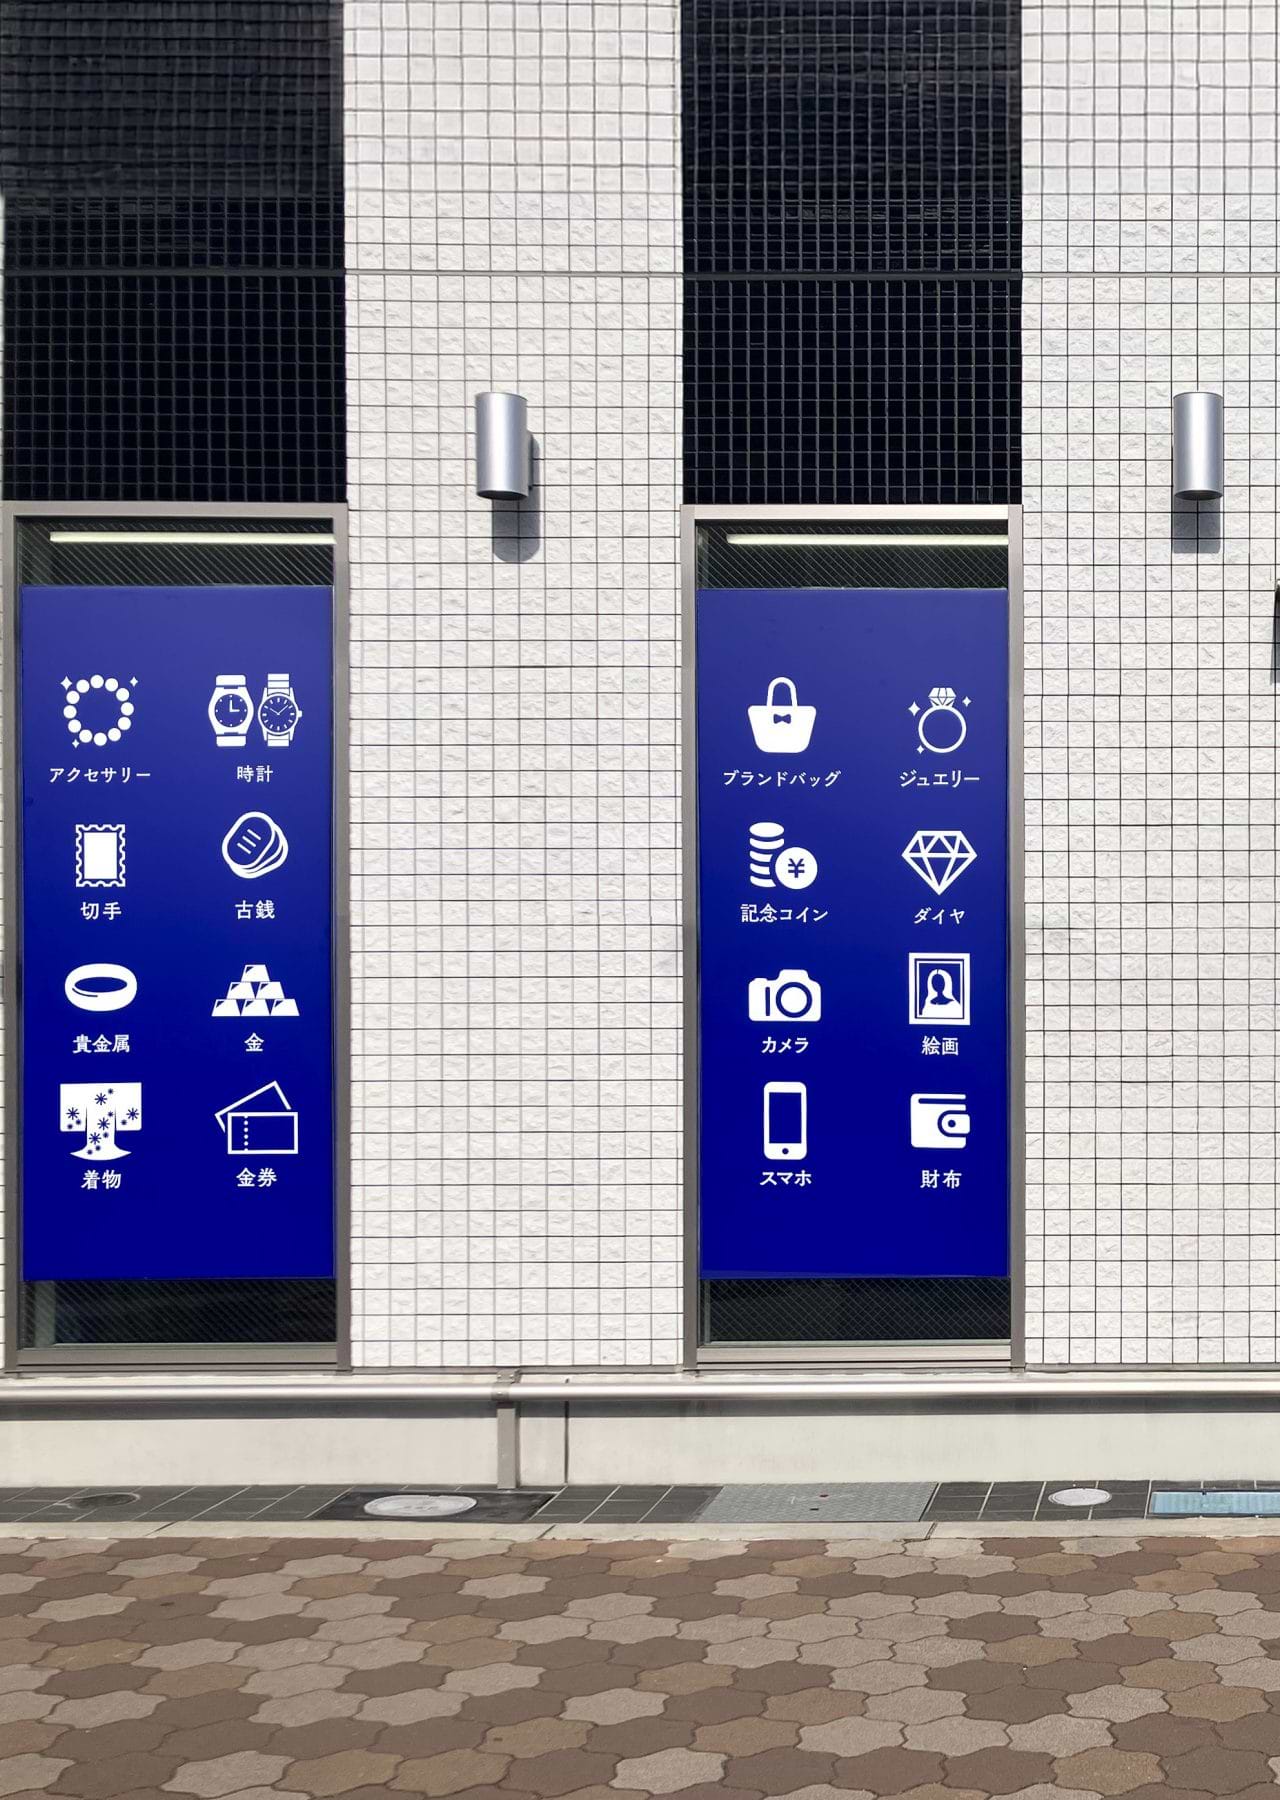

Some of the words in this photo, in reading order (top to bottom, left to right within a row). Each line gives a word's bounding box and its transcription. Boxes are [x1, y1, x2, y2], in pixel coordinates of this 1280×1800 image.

[49, 766, 151, 783] アクセサリー
[236, 764, 274, 783] 時計
[723, 769, 842, 788] ブランドバッグ
[899, 769, 980, 788] ジュエリー
[80, 901, 122, 921] 切手
[234, 899, 276, 920] 古銭
[741, 903, 829, 923] 記念コイン
[914, 906, 965, 925] ダイヤ
[72, 1033, 130, 1054] 貴金属
[244, 1032, 265, 1052] 金
[761, 1036, 809, 1054] カメラ
[921, 1035, 959, 1056] 絵画
[80, 1169, 122, 1190] 着物
[236, 1167, 277, 1188] 金券
[759, 1169, 812, 1187] スマホ
[920, 1169, 962, 1189] 財布
